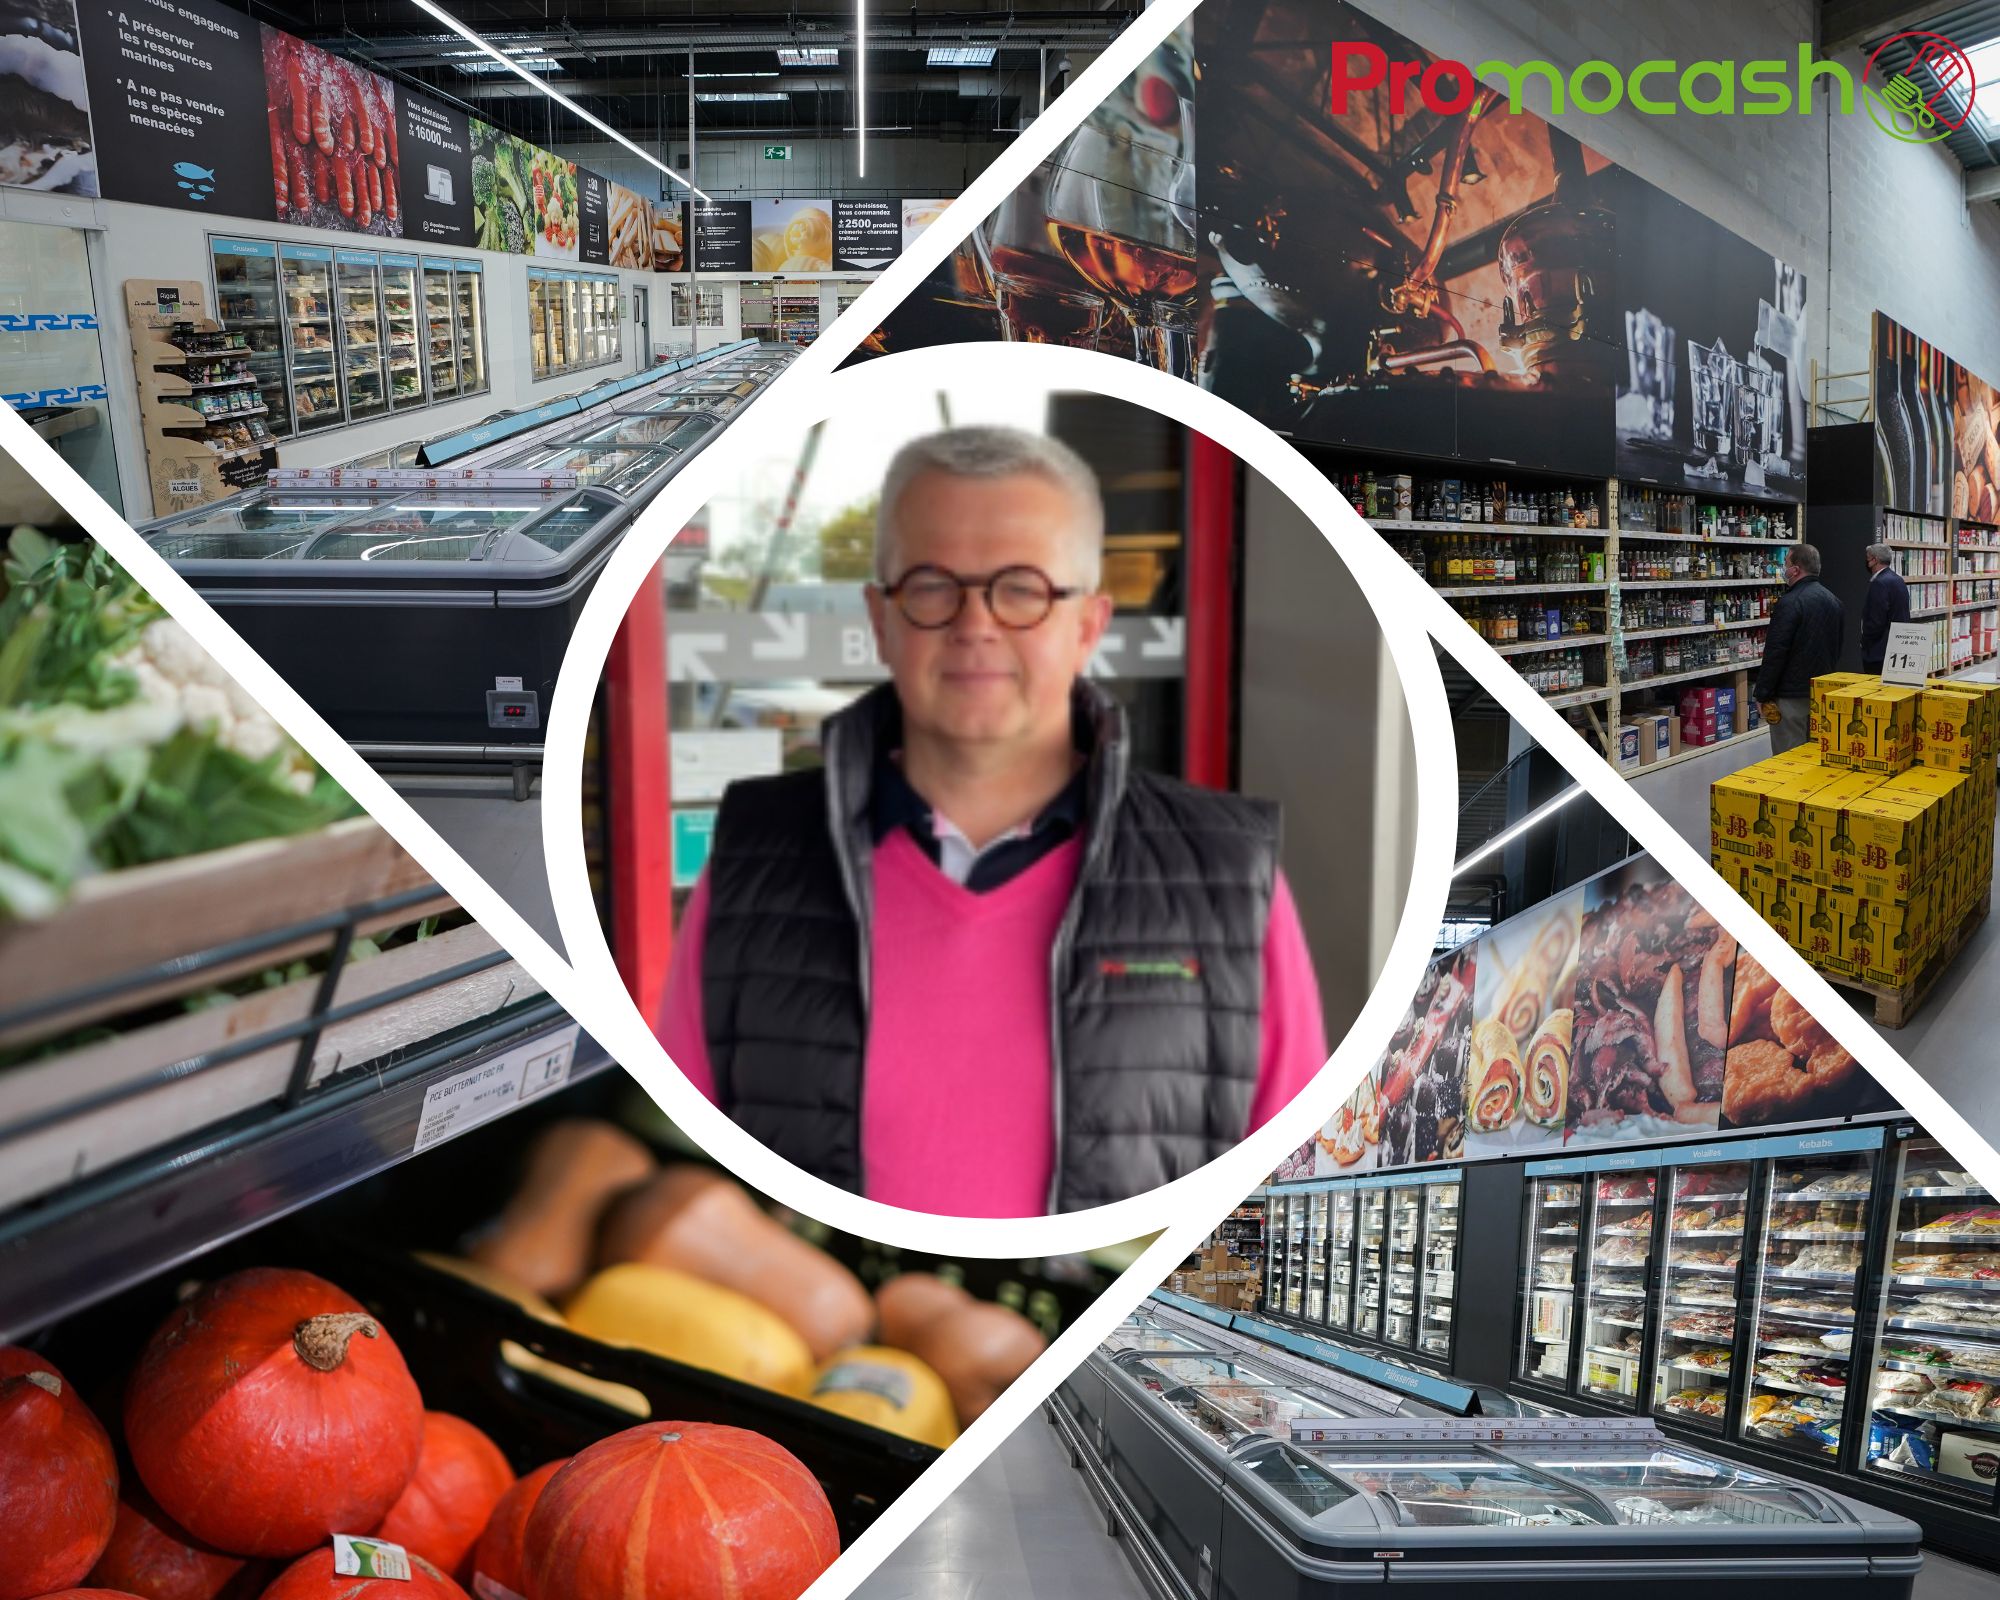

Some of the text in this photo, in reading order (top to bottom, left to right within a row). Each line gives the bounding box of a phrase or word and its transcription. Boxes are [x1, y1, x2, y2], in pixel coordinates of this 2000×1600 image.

[118, 12, 195, 50] A préserver
[145, 0, 240, 40] ous engageons
[118, 27, 213, 71] les ressources
[121, 47, 175, 73] marines
[126, 78, 225, 117] A ne pas vendre
[406, 97, 421, 112] Vous
[127, 94, 203, 125] les espèces
[407, 110, 421, 122] vous
[129, 113, 195, 138] menacées
[415, 124, 442, 146] 16000
[854, 202, 889, 210] choisissez,
[845, 218, 872, 229] 2500
[872, 222, 898, 230] produits
[471, 430, 491, 442] Glaces
[1890, 653, 1908, 669] 11
[1932, 720, 1955, 743] J&B
[1849, 741, 1868, 759] J&B
[1725, 815, 1748, 839] J&B
[1756, 840, 1775, 860] J&B
[1792, 849, 1812, 871] J&B
[1861, 843, 1888, 871] J&B
[1833, 857, 1853, 879] J&B
[1811, 935, 1831, 954] J&B
[1852, 946, 1871, 967] J&B
[430, 1088, 442, 1103] PCE
[443, 1073, 483, 1097] BUTTERNUT
[1692, 1148, 1722, 1159] Volailles
[1799, 1138, 1834, 1149] Kebabs
[1383, 1368, 1420, 1388] Pâtisseries
